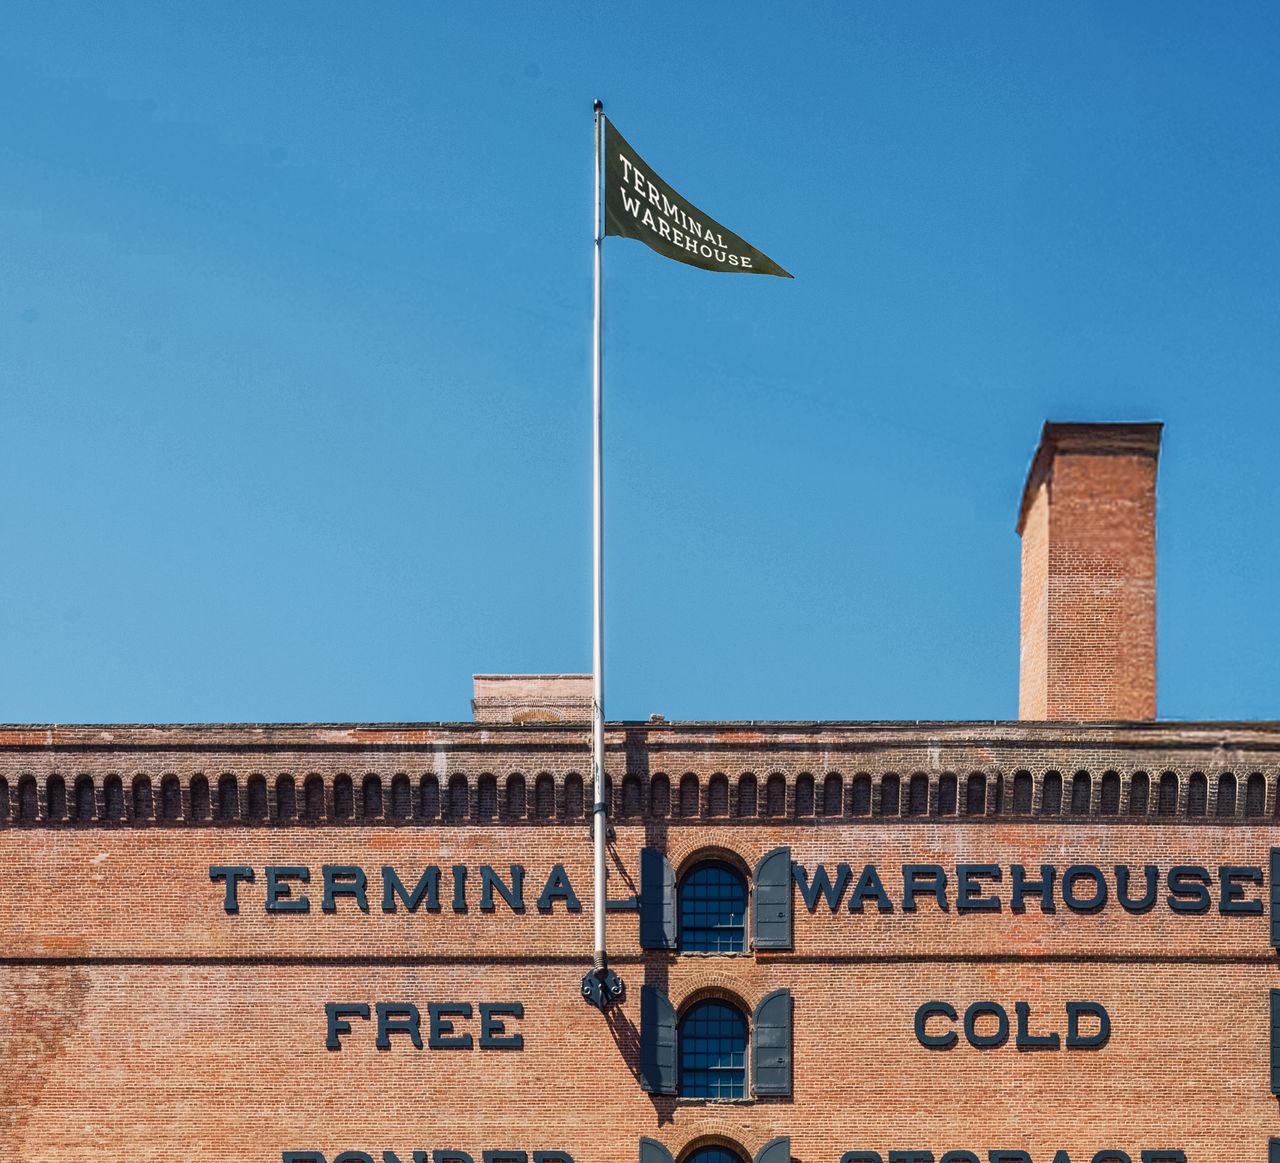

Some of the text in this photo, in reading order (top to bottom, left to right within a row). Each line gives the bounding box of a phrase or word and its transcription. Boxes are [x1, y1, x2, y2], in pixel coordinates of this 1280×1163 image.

[619, 153, 729, 249] TERMINAL
[620, 186, 754, 269] WAREHOUSE
[792, 863, 1265, 915] WAREHOUSE
[324, 1001, 524, 1051] FREE
[913, 1000, 1112, 1051] COLD
